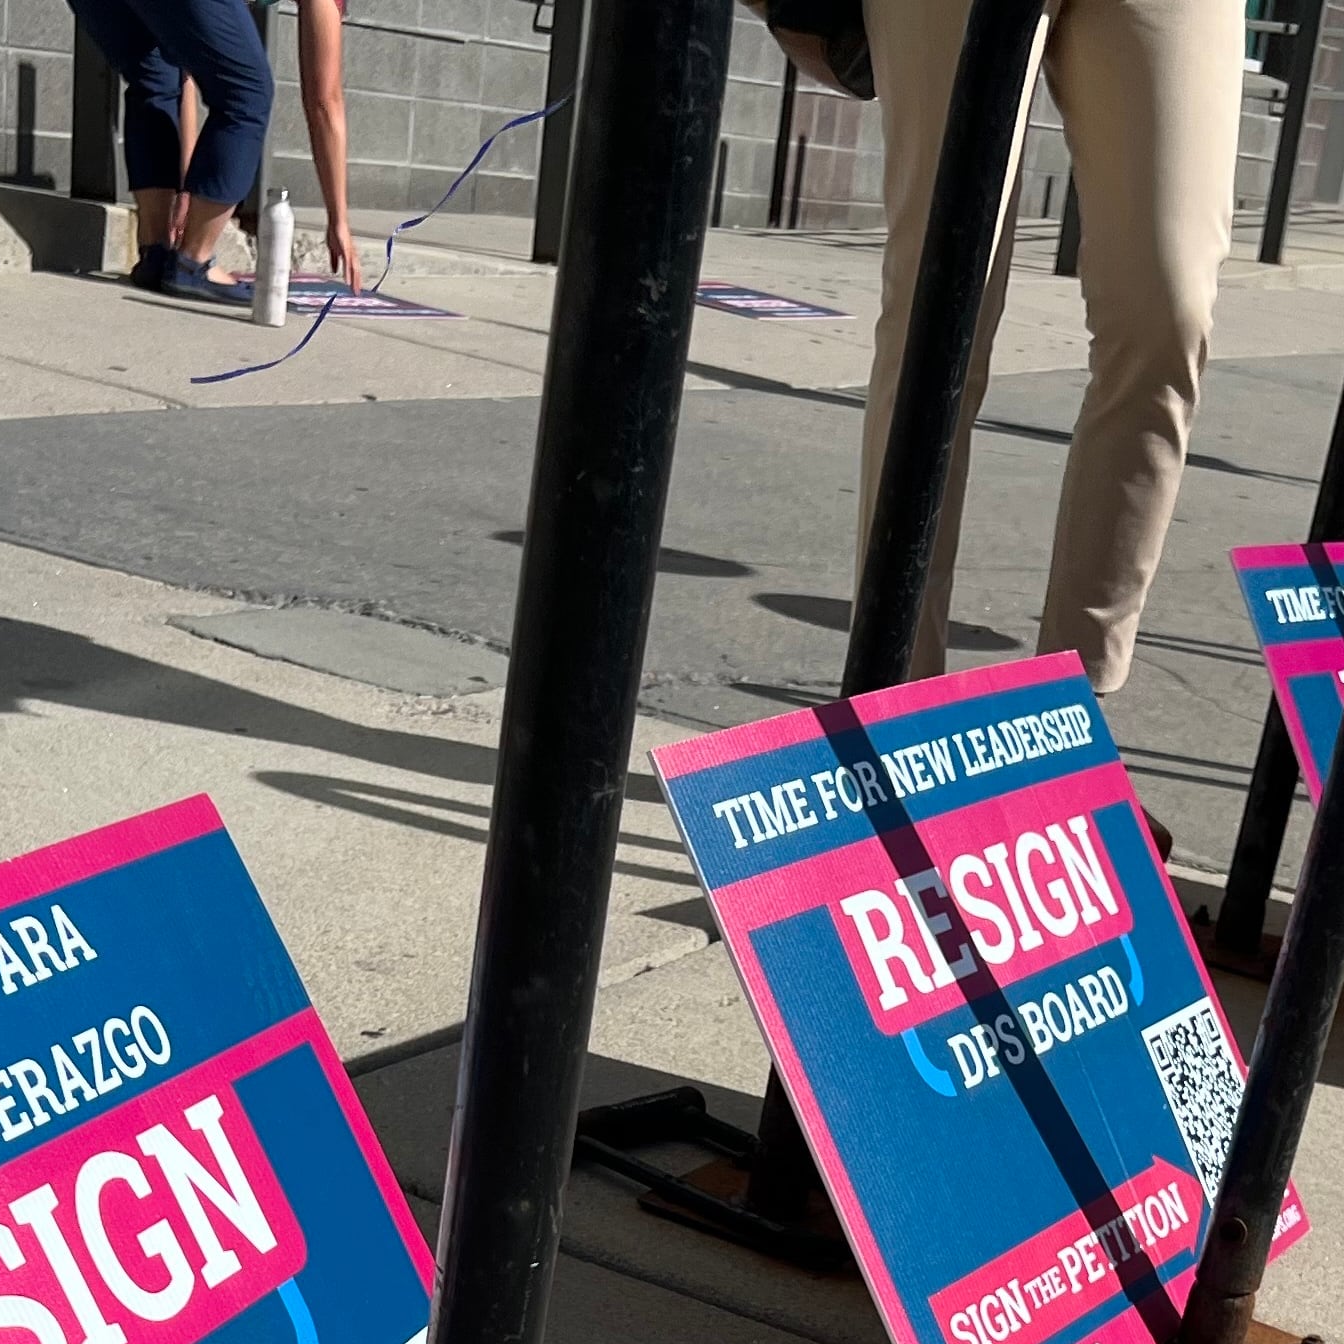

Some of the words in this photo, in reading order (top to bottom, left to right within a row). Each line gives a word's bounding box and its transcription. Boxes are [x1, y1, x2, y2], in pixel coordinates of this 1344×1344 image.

[1265, 585, 1327, 624] TIME
[712, 778, 818, 850] TIME
[816, 759, 889, 828] FOR
[881, 738, 958, 800] NEW
[952, 704, 1094, 772] LEADERSHIP
[840, 814, 1120, 1011] RESIGN
[947, 1013, 1026, 1089] DPS
[1017, 965, 1129, 1055] BOARD
[1024, 1266, 1068, 1310] THE
[1058, 1181, 1190, 1294] PETITION
